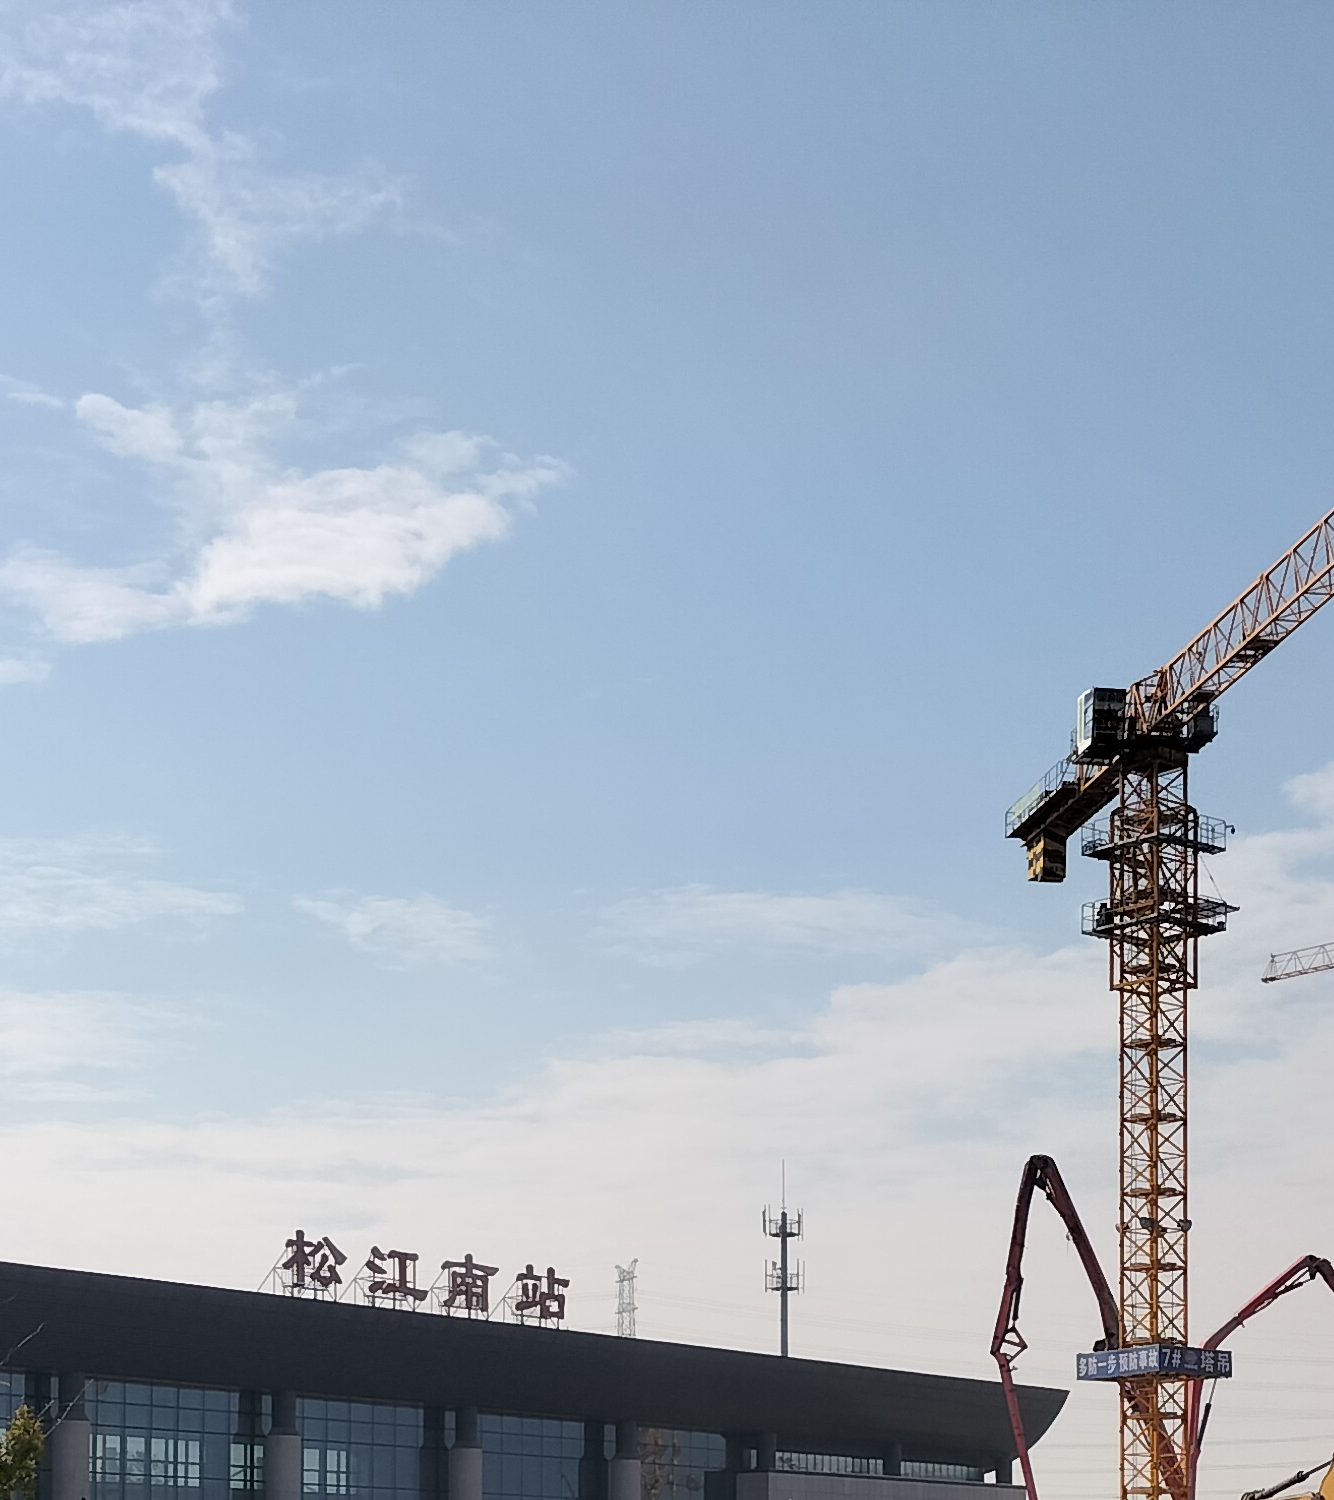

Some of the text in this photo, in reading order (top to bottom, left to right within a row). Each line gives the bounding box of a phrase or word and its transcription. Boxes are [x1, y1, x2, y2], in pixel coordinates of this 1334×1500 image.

[282, 1230, 569, 1320] 松江南站
[1078, 1348, 1158, 1377] 多防一步 预防事故
[1200, 1351, 1230, 1373] 塔吊
